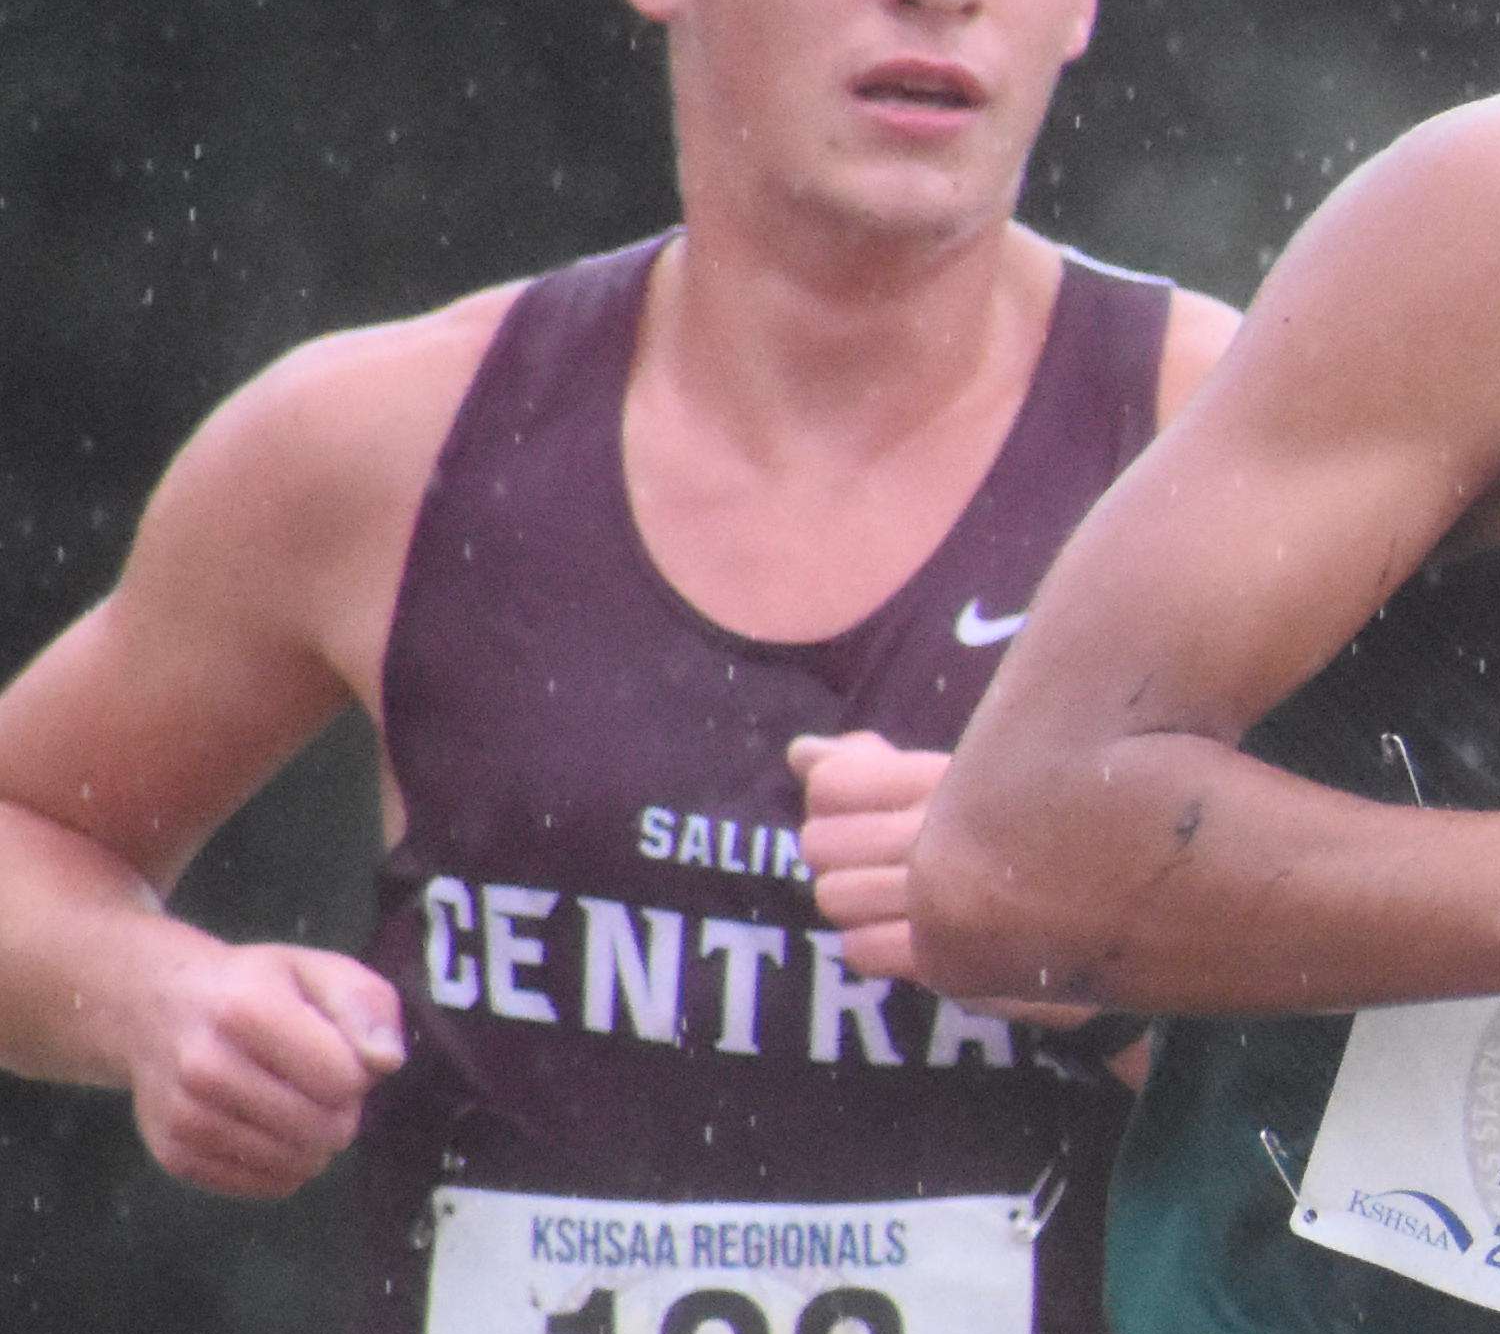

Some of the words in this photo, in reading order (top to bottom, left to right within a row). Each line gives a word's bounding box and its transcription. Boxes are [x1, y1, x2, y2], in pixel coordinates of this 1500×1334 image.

[638, 804, 810, 881] SALIN
[423, 876, 1050, 1072] CENTRA
[531, 1216, 677, 1267] KSHSAA
[692, 1218, 908, 1267] REGIONALS
[1349, 1189, 1448, 1251] KSHSAA
